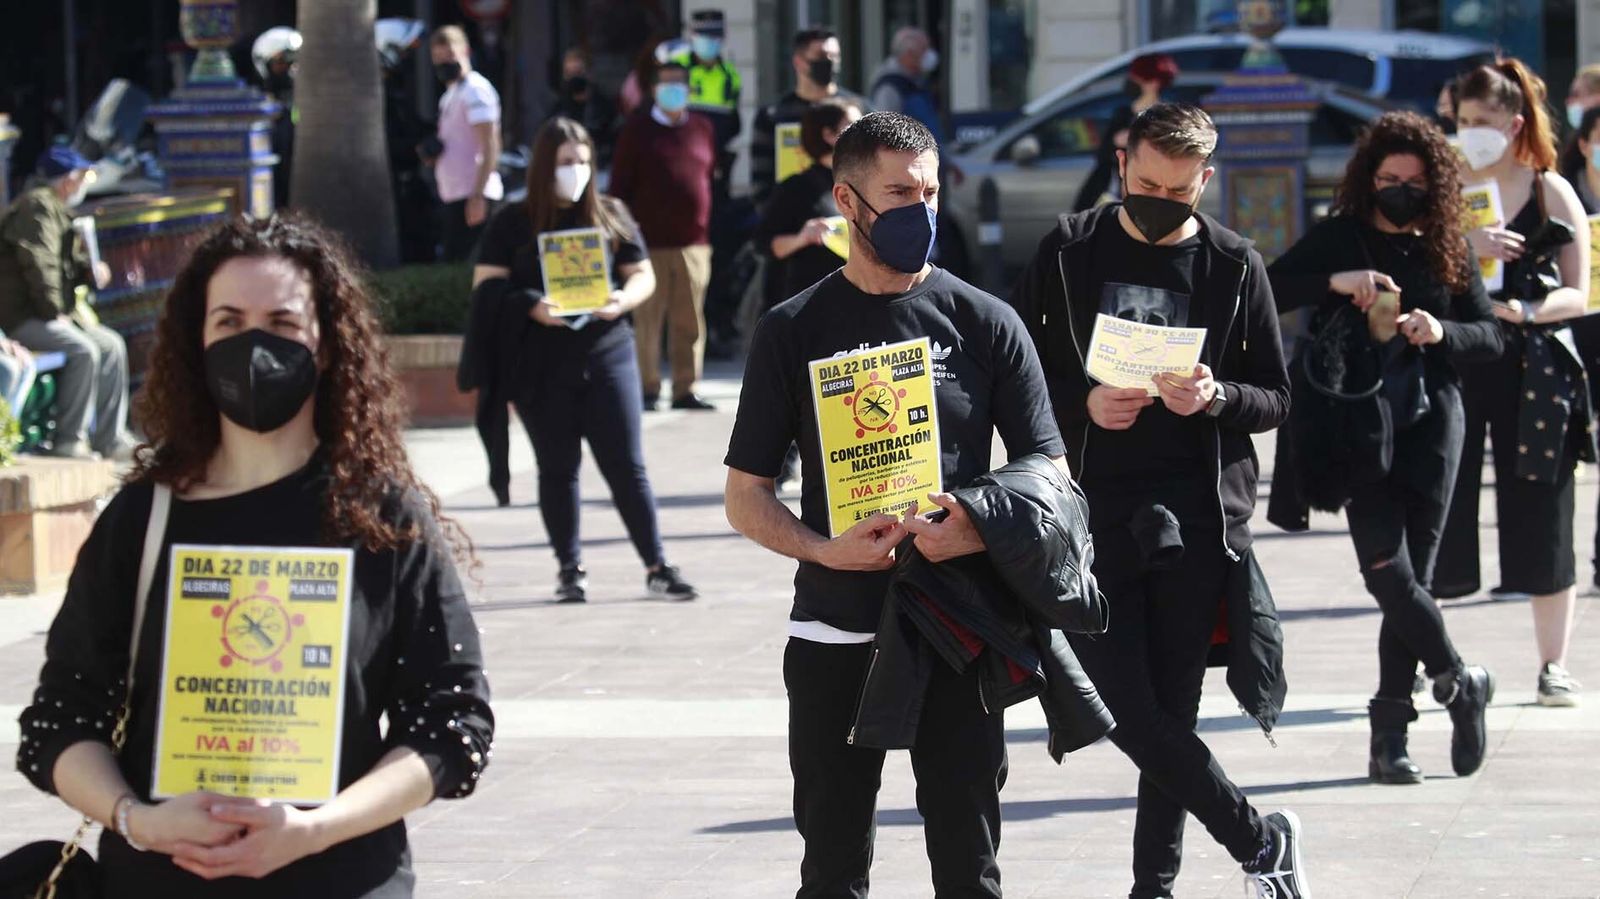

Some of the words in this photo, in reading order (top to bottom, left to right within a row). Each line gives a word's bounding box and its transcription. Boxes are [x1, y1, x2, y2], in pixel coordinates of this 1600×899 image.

[819, 367, 843, 380] DIA
[843, 361, 859, 375] 22
[862, 356, 878, 370] DE
[881, 347, 923, 367] MARZO
[892, 366, 910, 377] PLAZA
[910, 363, 924, 373] ALTA
[822, 379, 854, 393] ALGECIRAS
[909, 410, 919, 421] 10
[919, 409, 928, 419] h.
[830, 429, 931, 463] CONCENTRACIÓN
[851, 448, 913, 473] NACIONAL
[850, 484, 874, 500] IVA
[877, 479, 888, 494] al
[891, 473, 918, 490] 10%
[184, 557, 214, 574] DIA
[220, 559, 243, 575] 22
[249, 560, 271, 576] DE
[276, 561, 339, 577] MARZO
[183, 580, 230, 593] ALGECIRAS
[290, 584, 313, 596] PLAZA
[314, 584, 337, 596] ALTA
[304, 648, 318, 663] 10
[175, 676, 331, 696] CONCENTRACIÓN
[204, 697, 297, 716] NACIONAL
[196, 734, 231, 753] IVA
[236, 735, 255, 753] al
[260, 736, 302, 755] 10%
